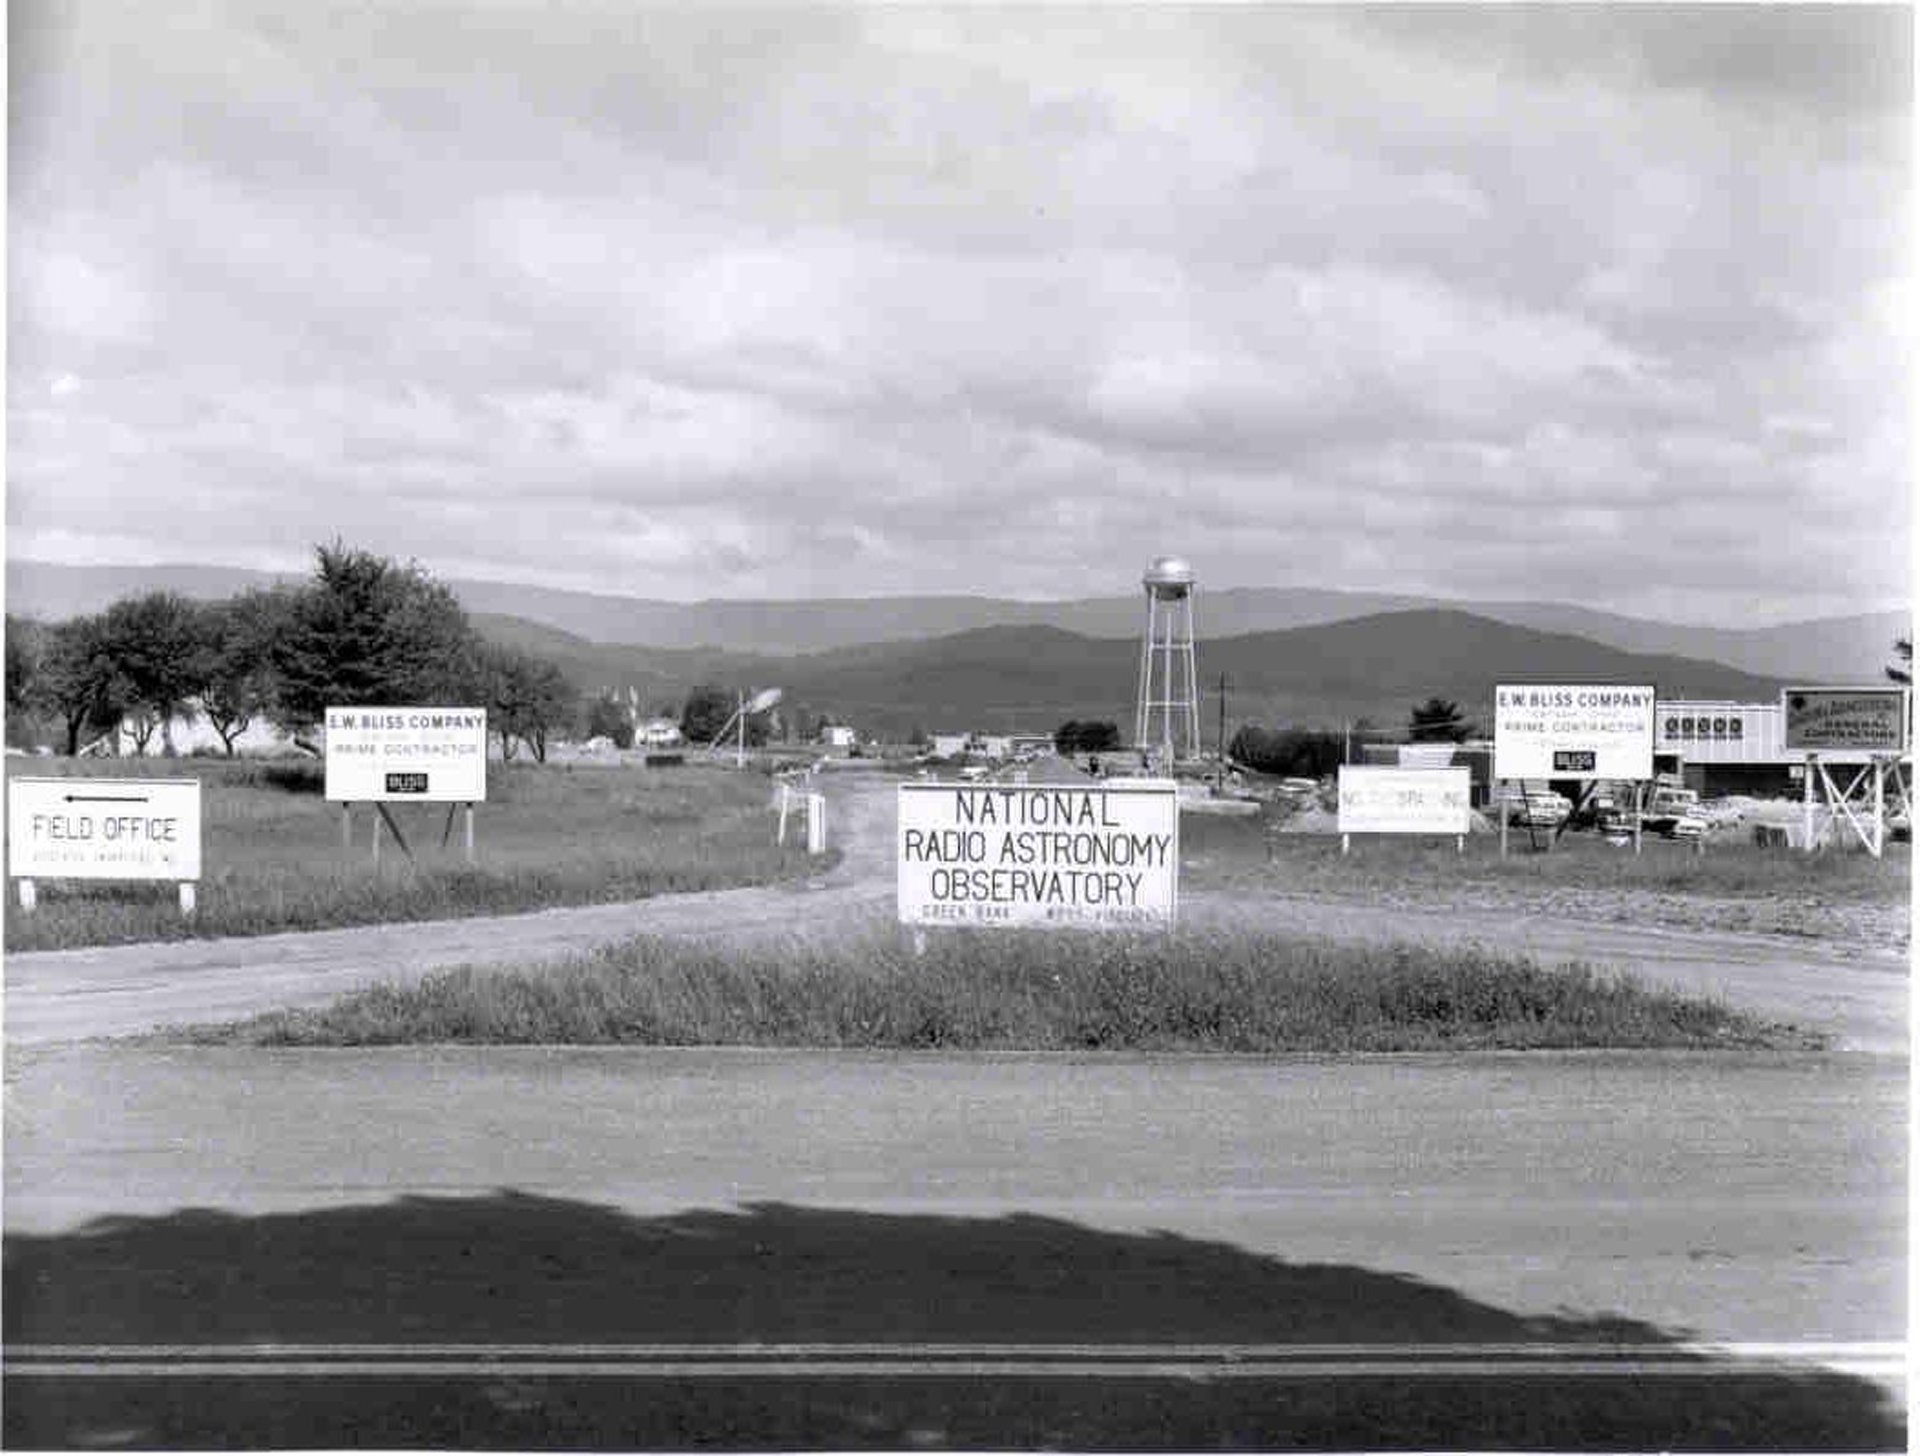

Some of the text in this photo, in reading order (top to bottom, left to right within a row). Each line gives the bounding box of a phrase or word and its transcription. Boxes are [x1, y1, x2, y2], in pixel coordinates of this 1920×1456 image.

[1530, 692, 1573, 708] BLISS
[1577, 692, 1651, 708] COMPANY
[361, 714, 404, 730] BLISS
[408, 714, 483, 730] COMPANY
[955, 789, 1121, 826] NATIONAL
[33, 815, 178, 842] FIELD OFFICE
[904, 828, 1171, 867] RADIO ASTRONOMY
[930, 868, 1143, 906] OBSERVATORY
